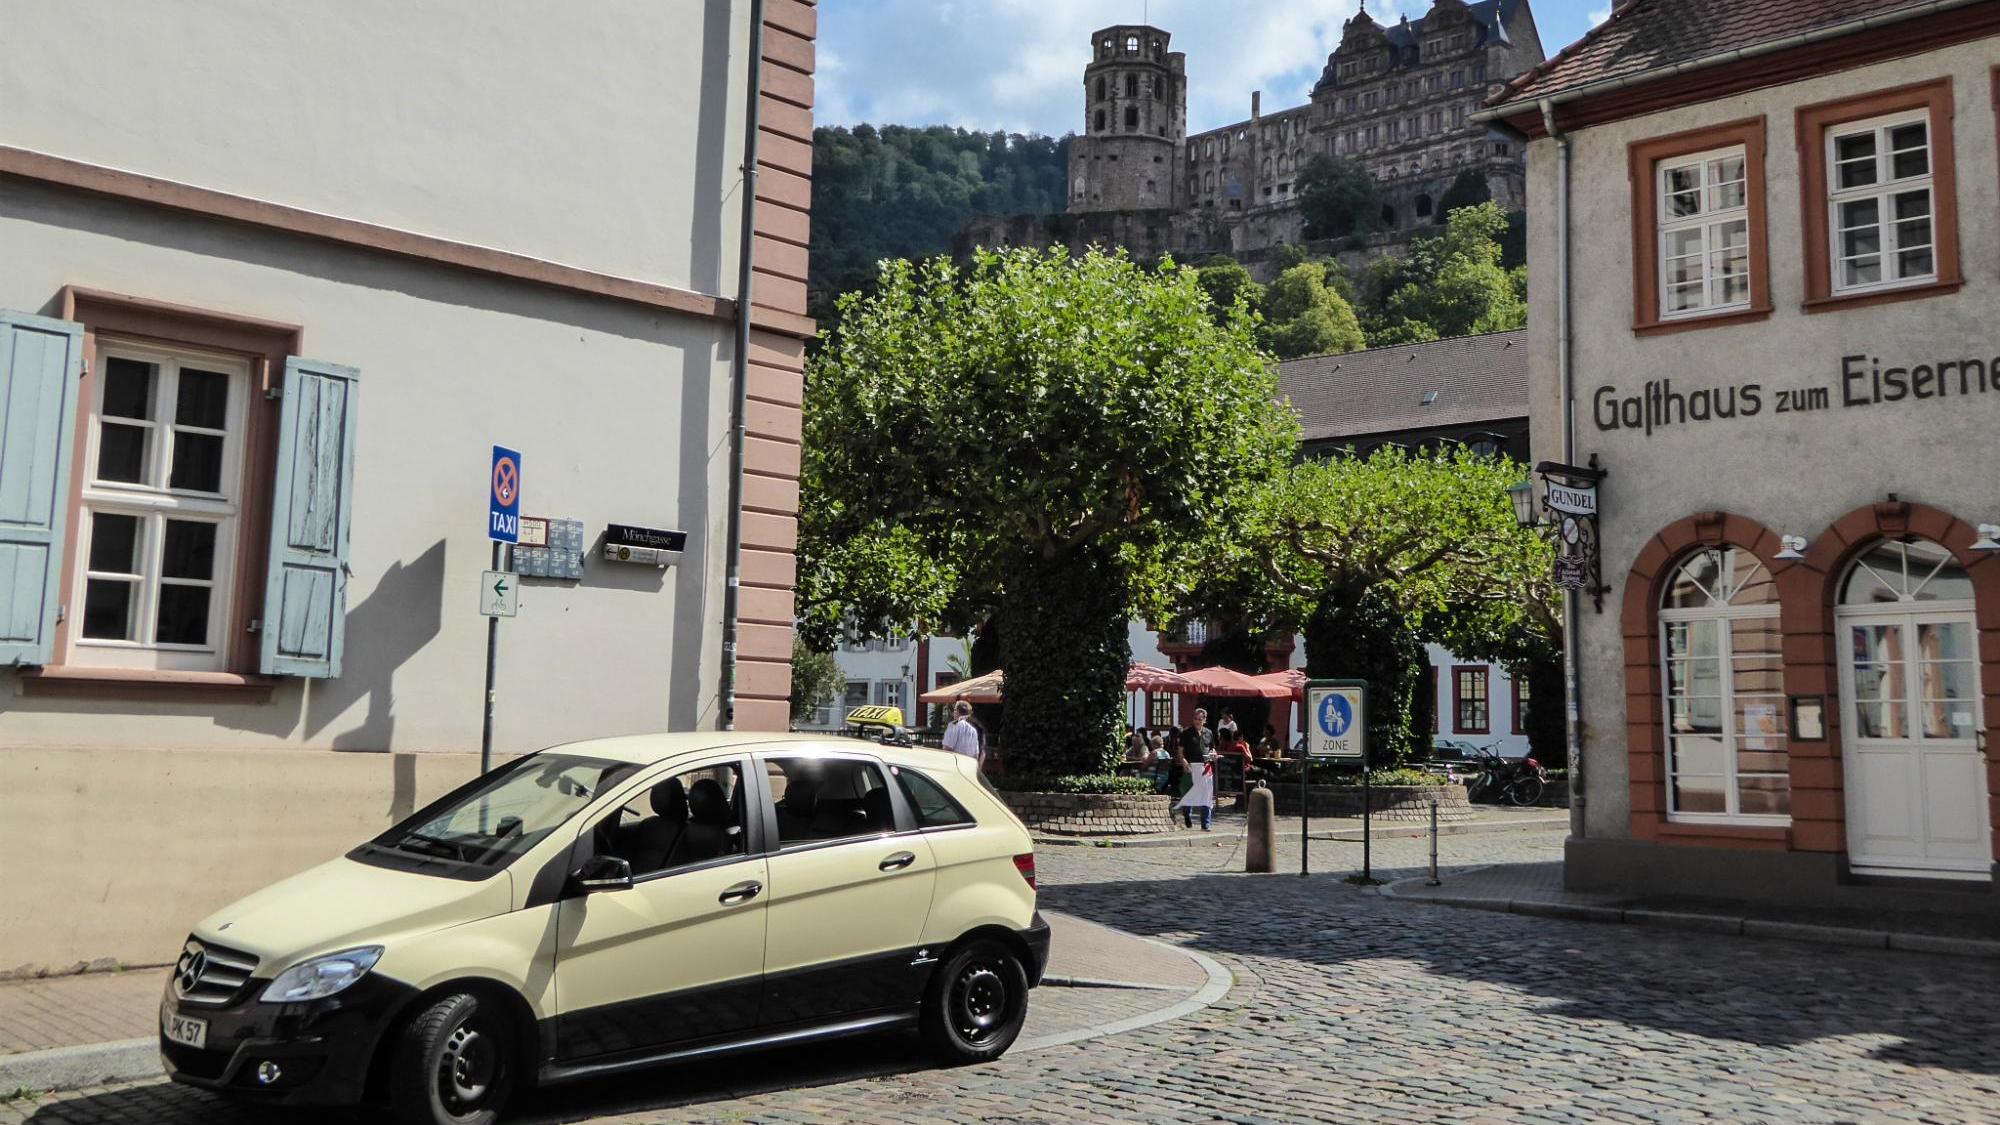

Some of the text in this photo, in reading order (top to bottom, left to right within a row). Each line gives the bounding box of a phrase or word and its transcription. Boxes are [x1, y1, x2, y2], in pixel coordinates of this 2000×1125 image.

[1775, 387, 1829, 413] zum
[1551, 489, 1594, 509] GUNDEL
[491, 511, 516, 535] TAXI
[622, 528, 672, 546] Mönchgasse
[849, 707, 891, 719] TAXI
[1322, 740, 1349, 751] ZONE
[186, 1022, 201, 1043] 57
